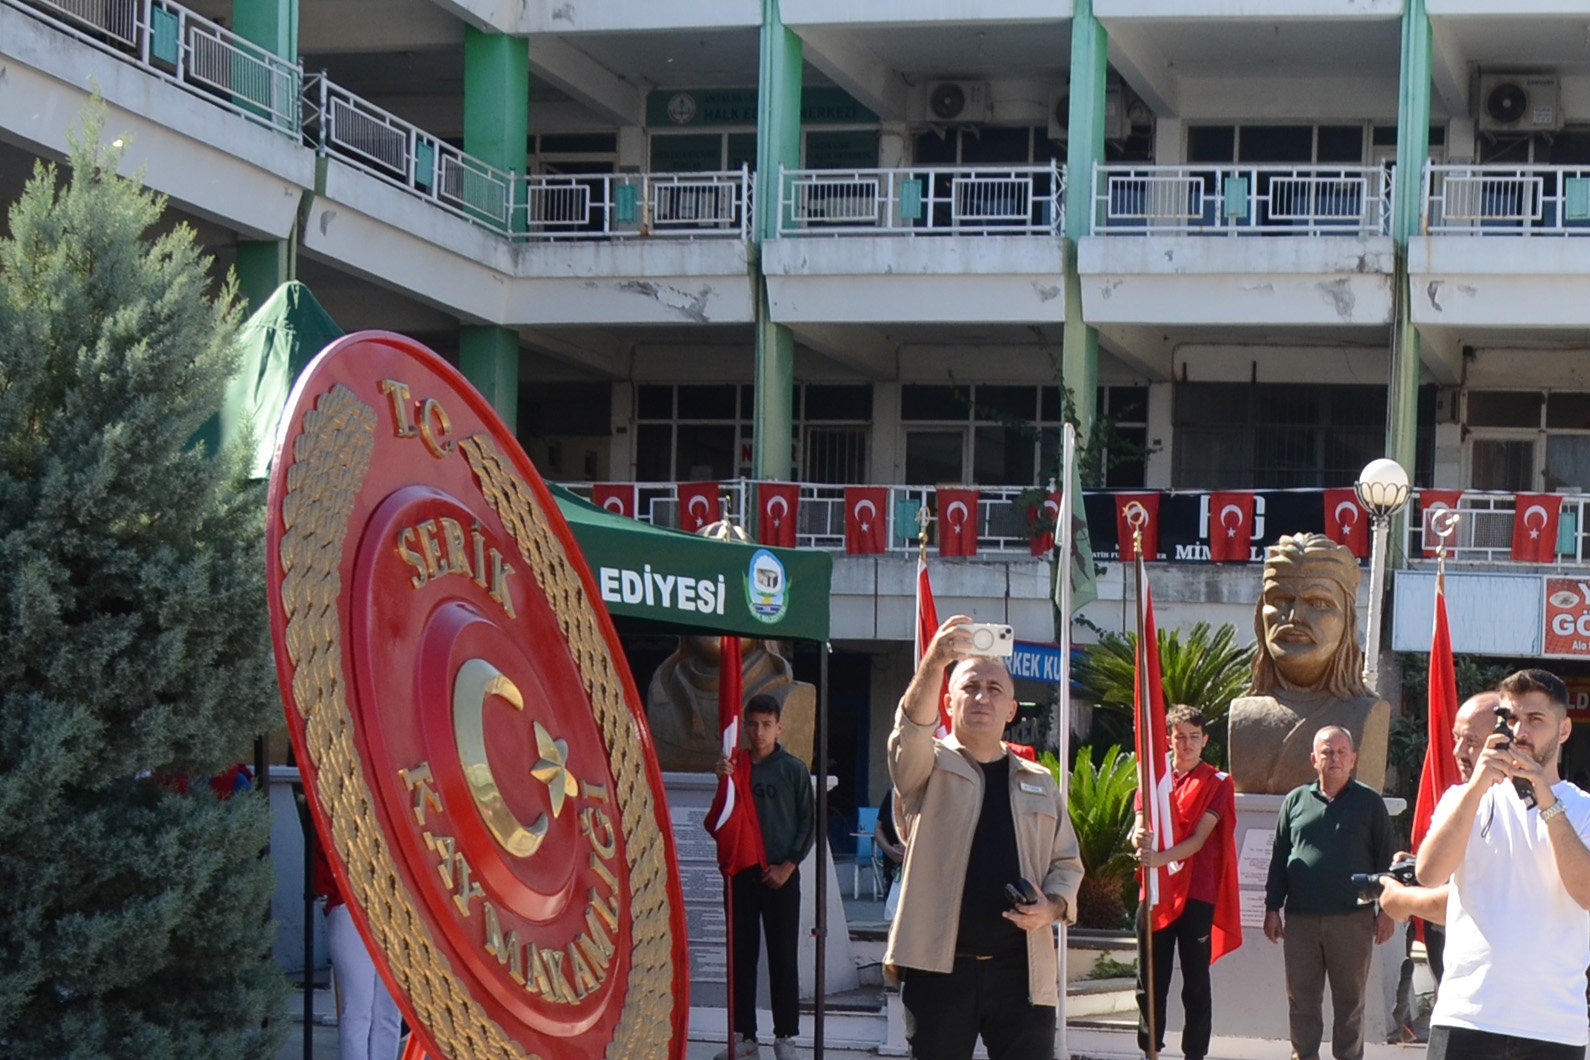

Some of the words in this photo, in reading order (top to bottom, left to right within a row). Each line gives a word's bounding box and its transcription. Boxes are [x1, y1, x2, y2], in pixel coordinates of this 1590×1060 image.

[397, 516, 517, 619] SERİK
[600, 564, 726, 615] EDİYESİ
[1572, 640, 1586, 650] Alo
